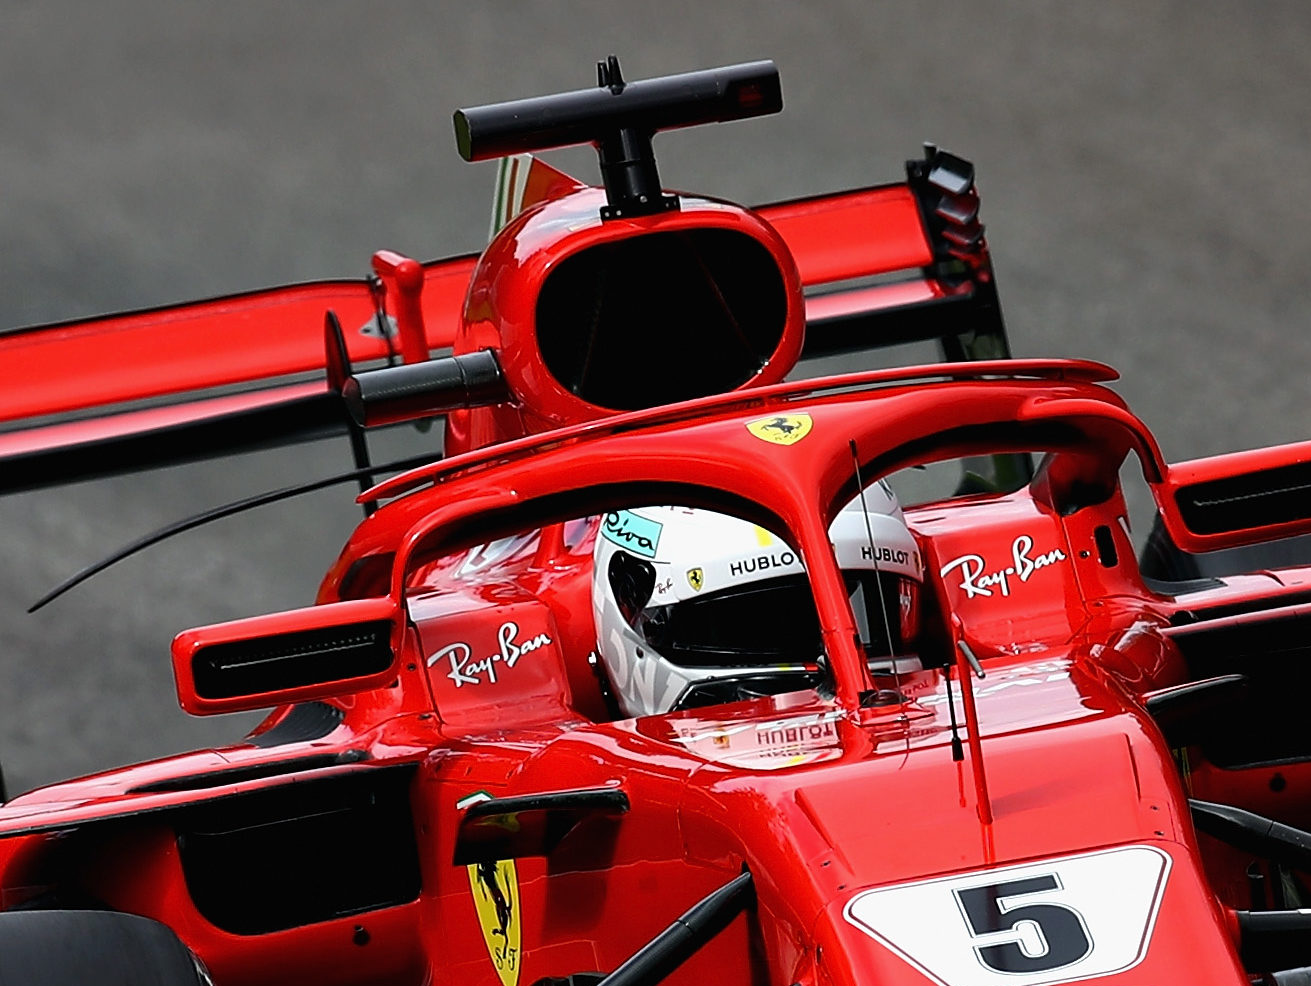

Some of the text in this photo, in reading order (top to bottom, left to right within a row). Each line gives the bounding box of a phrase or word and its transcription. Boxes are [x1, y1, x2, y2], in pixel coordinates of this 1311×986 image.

[730, 552, 795, 576] HUBLO
[861, 546, 909, 565] HUBLOT
[940, 535, 1066, 599] Ray-Ban
[426, 621, 551, 688] Ray-Ban
[953, 875, 1094, 974] 5
